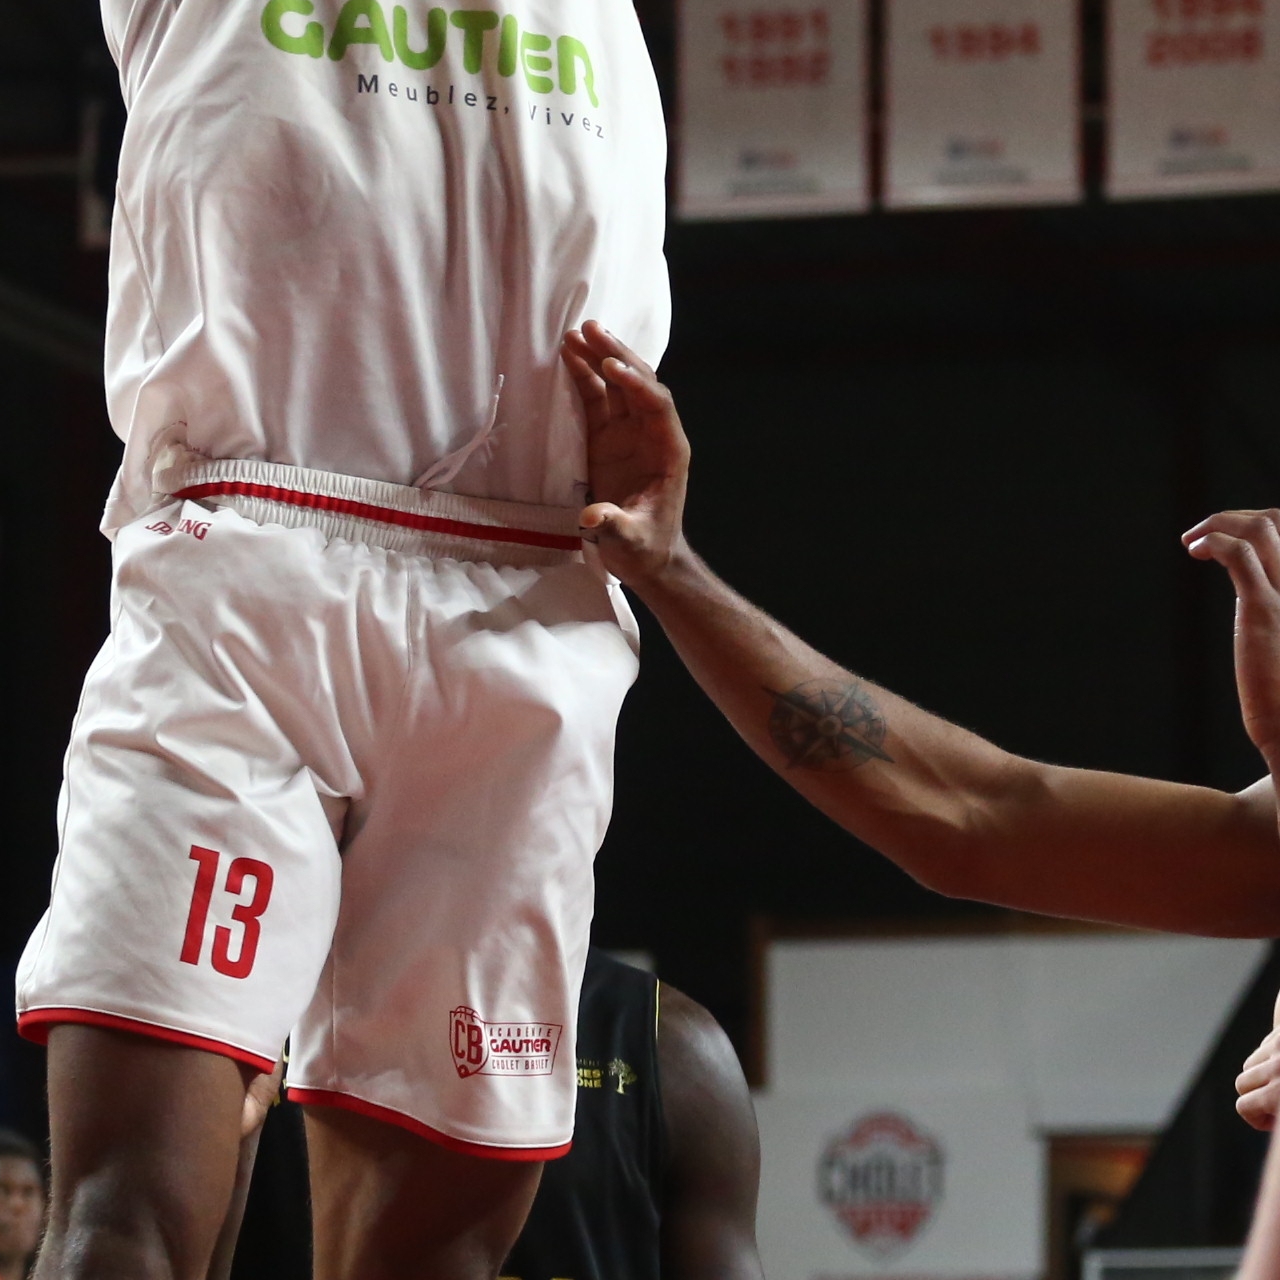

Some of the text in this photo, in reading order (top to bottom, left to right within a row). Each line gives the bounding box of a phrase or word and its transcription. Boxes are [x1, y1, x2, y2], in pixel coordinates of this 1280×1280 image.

[357, 74, 510, 114] Meublez,
[179, 844, 275, 980] 13
[454, 1019, 483, 1065] CB
[490, 1038, 552, 1053] GAUTIER
